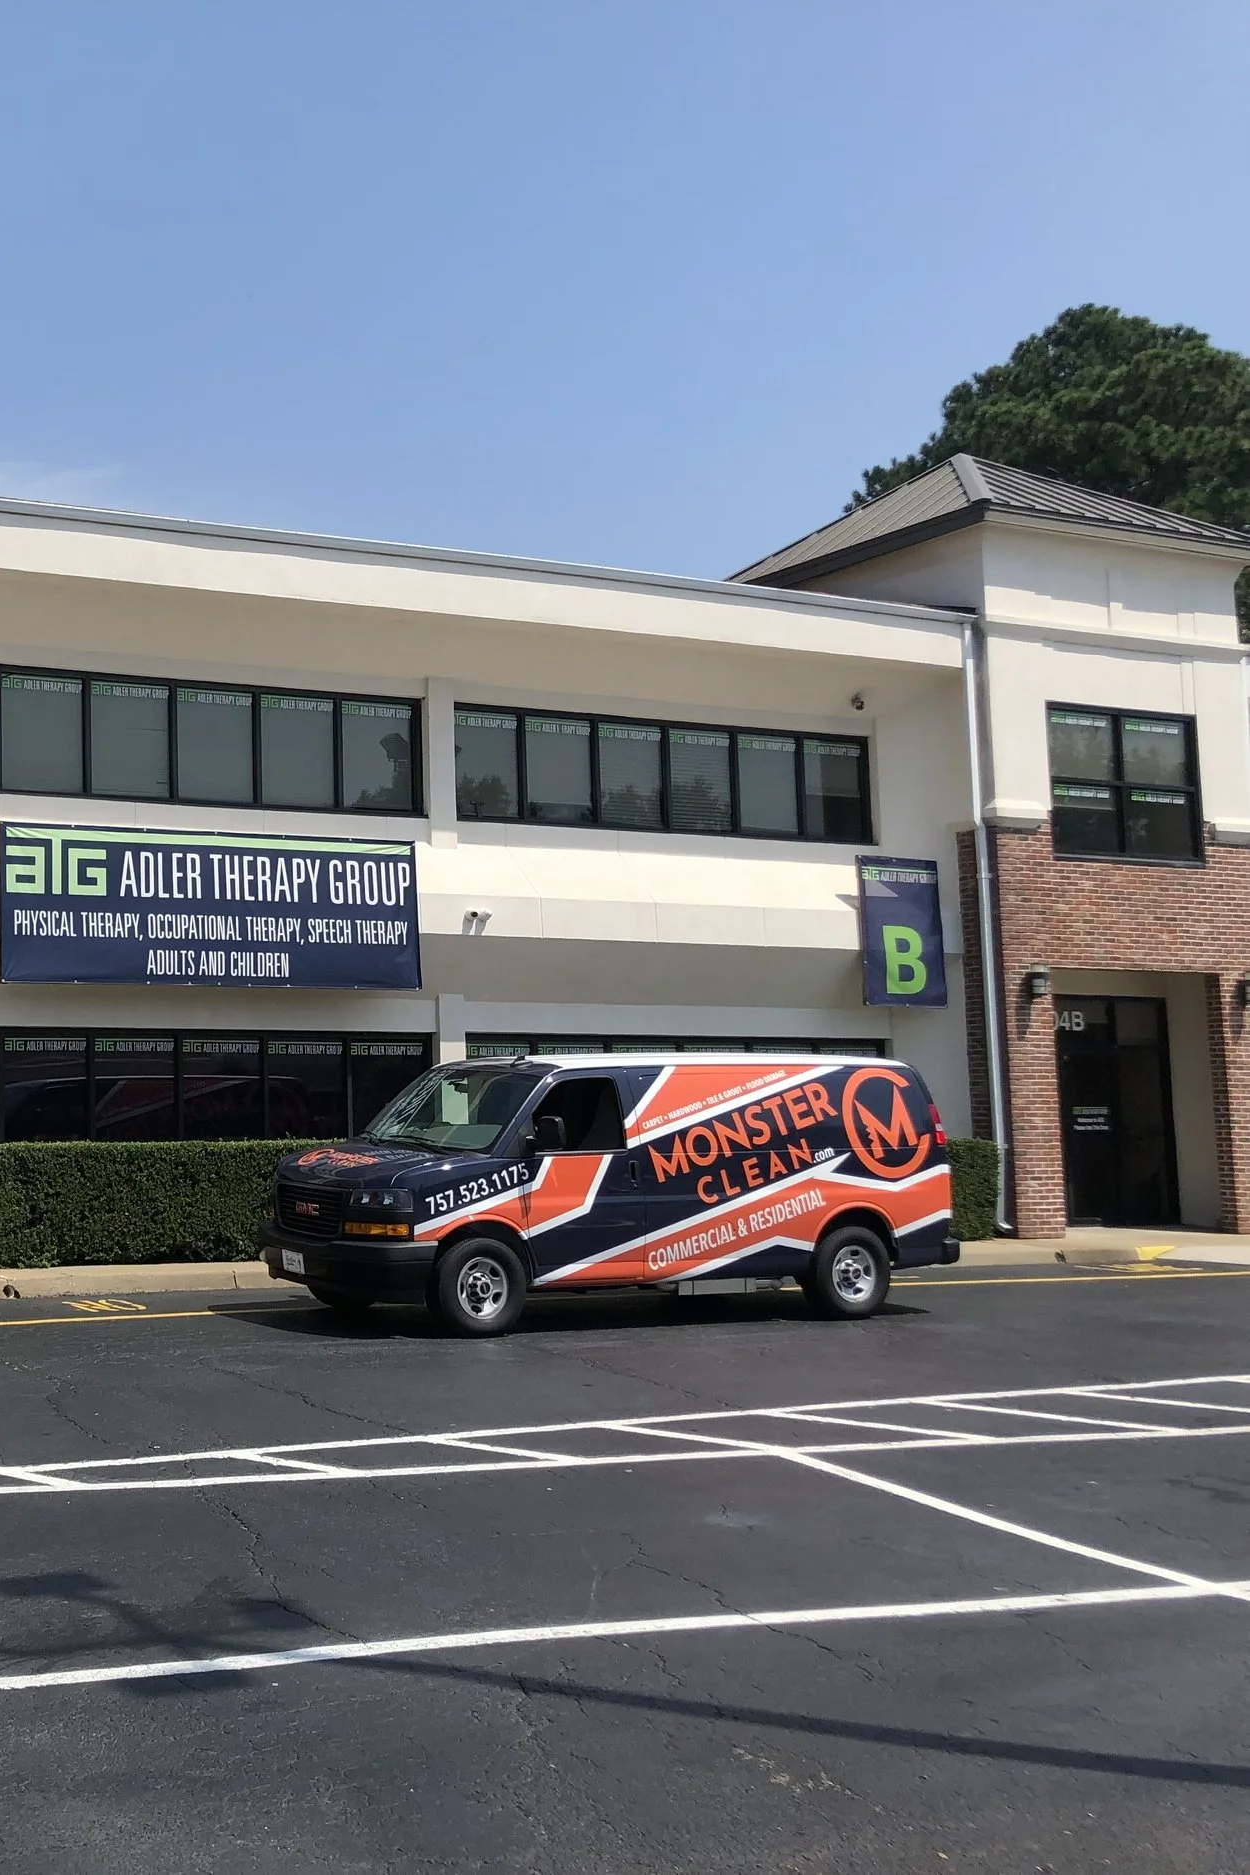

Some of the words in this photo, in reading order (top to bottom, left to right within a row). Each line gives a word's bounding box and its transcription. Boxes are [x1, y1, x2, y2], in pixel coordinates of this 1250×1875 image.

[24, 680, 40, 690] ADLER
[41, 681, 63, 692] THERAPY
[65, 683, 82, 694] GROUP
[113, 687, 129, 697] ADLER
[131, 688, 151, 698] THERAPY
[153, 690, 169, 700] GROUP
[120, 851, 202, 899] ADLER
[210, 854, 320, 903] THERAPY
[330, 859, 410, 907] GROUP
[14, 909, 77, 937] PHYSICAL
[81, 912, 144, 941] THERAPY,
[148, 914, 242, 941] OCCUPATIONAL
[246, 916, 304, 945] THERAPY,
[308, 918, 352, 943] SPEECH
[355, 920, 408, 945] THERAPY
[147, 949, 194, 976] ADULTS
[199, 950, 225, 976] AND
[230, 951, 289, 978] CHILDREN
[883, 925, 926, 994] B
[27, 1041, 43, 1051] ADLER
[45, 1041, 67, 1051] THERAPY
[69, 1042, 86, 1051] GROUP
[116, 1042, 132, 1051] ADLER
[134, 1042, 155, 1051] THERAPY
[157, 1042, 174, 1051] GROUP
[203, 1043, 219, 1053] ADLER
[220, 1043, 241, 1053] THERAPY
[243, 1044, 259, 1053] GROUP
[642, 1115, 664, 1129] CARPET
[668, 1101, 703, 1120] HARDWOOD
[706, 1095, 719, 1105] TILE
[723, 1085, 743, 1100] GROUT
[745, 1078, 763, 1090] FLOOD
[648, 1082, 838, 1183] MONSTER
[425, 1163, 529, 1215] 757.523.1175
[648, 1223, 736, 1270] COMMERCIAL
[737, 1218, 748, 1237] &
[749, 1188, 826, 1232] RESIDENTIAL
